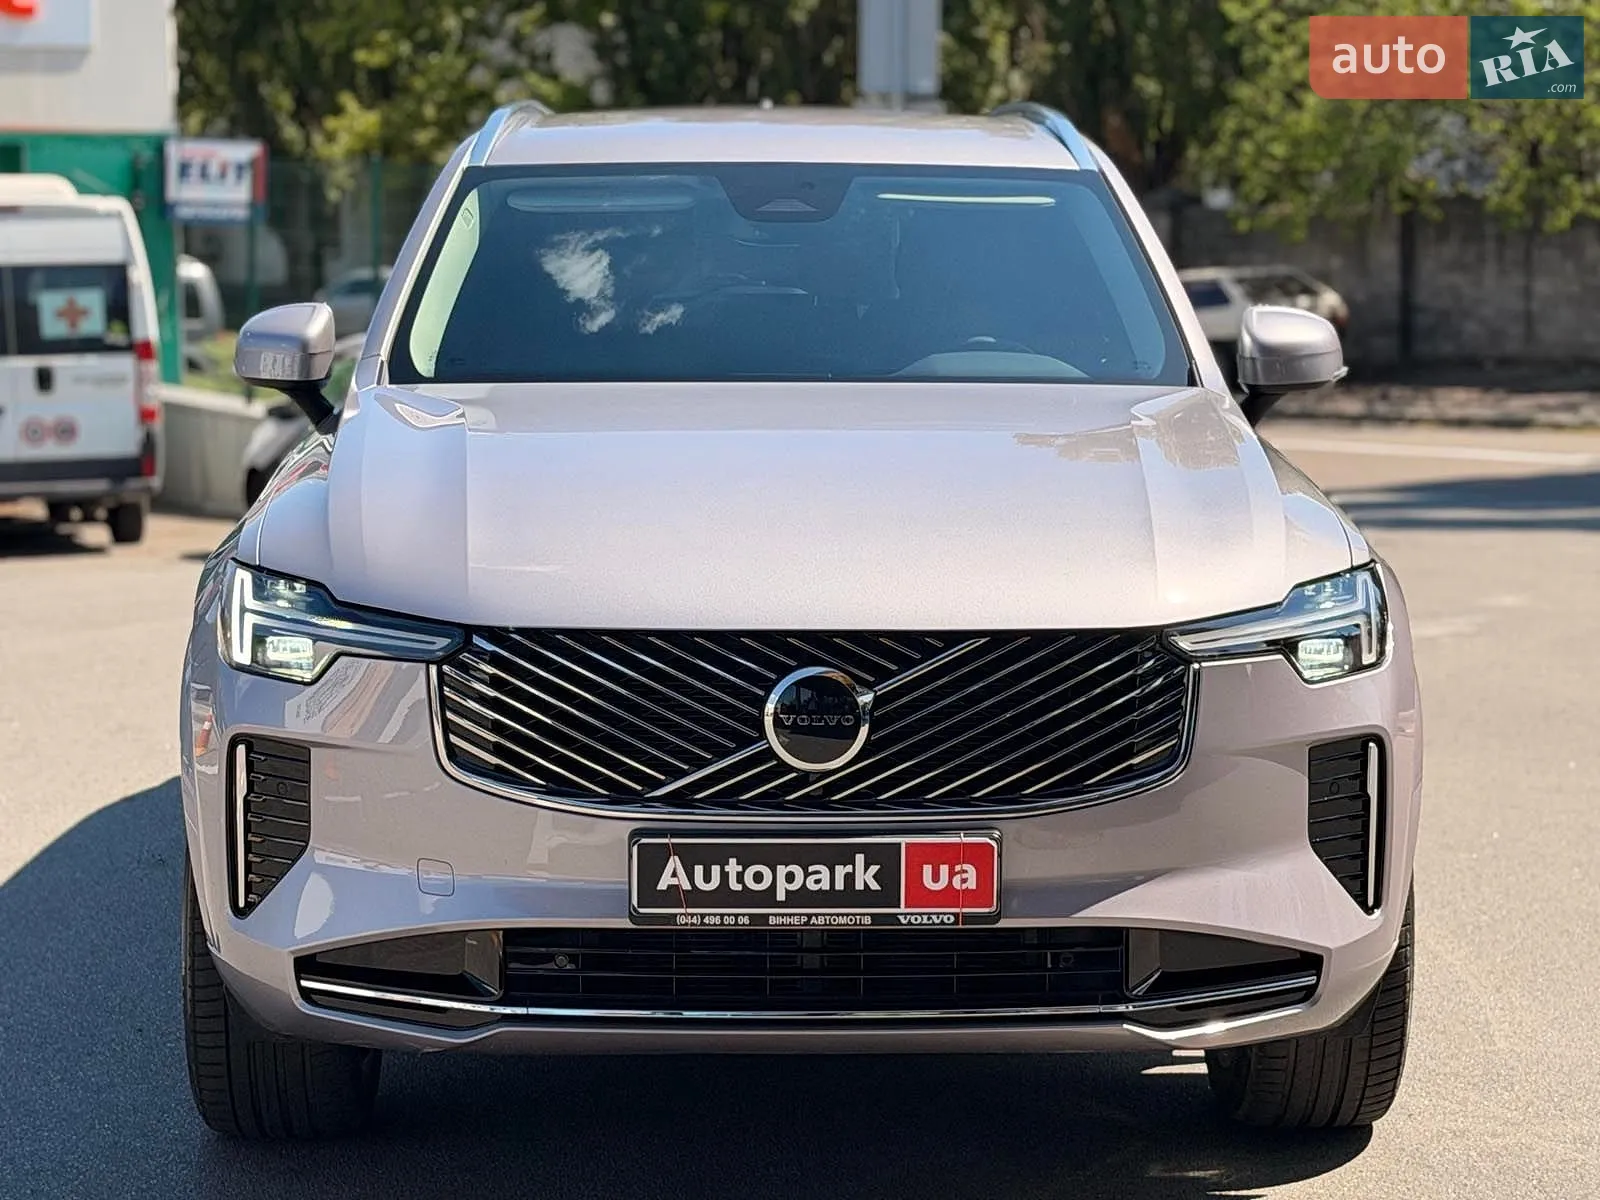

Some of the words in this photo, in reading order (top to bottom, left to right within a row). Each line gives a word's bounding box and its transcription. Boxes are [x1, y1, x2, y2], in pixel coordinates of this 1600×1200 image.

[779, 714, 855, 726] VOLVO
[656, 853, 881, 901] Autopark
[922, 863, 977, 890] ua
[703, 915, 721, 925] 496
[723, 915, 736, 925] 00
[738, 915, 750, 925] 06
[897, 914, 956, 924] VOLVO
